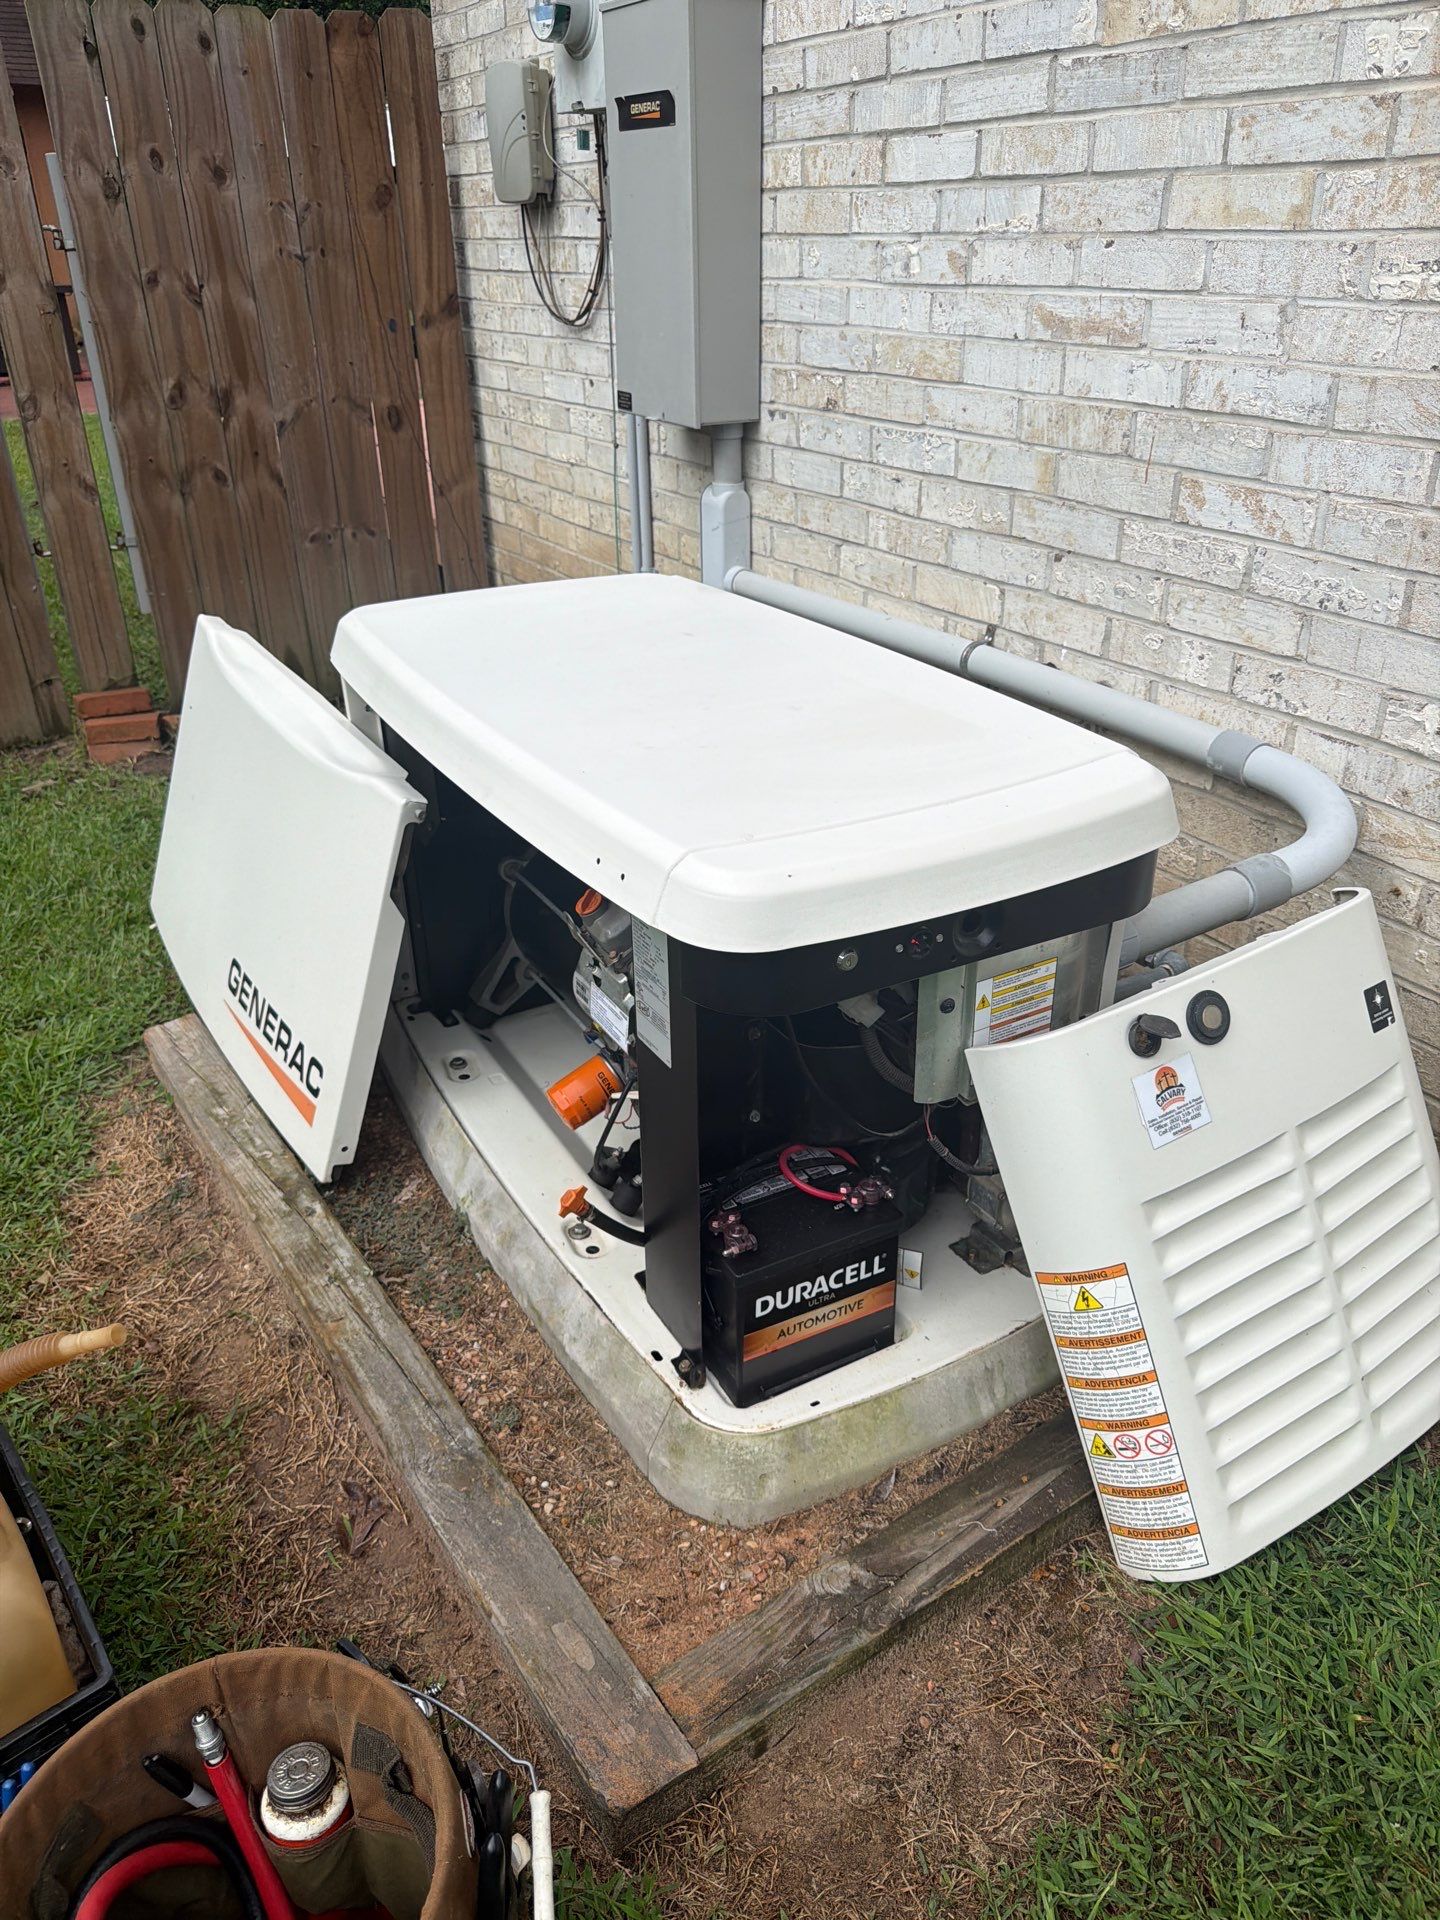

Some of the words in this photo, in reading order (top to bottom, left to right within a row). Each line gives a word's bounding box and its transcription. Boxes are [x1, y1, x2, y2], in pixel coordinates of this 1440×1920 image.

[630, 100, 661, 115] GENERAC
[227, 957, 324, 1099] GENERAC
[1156, 1088, 1186, 1107] CALVARY
[1063, 1271, 1108, 1282] WARNING
[755, 1255, 886, 1318] DURACELL
[808, 1292, 836, 1307] ULTRA
[777, 1299, 865, 1340] AUTOMOTIVE
[1068, 1332, 1142, 1347] AVERTISSEMENT
[1085, 1375, 1148, 1388] ADVERTENCIA
[1106, 1420, 1150, 1430] WARNING
[1111, 1484, 1184, 1497] AVERTISSEMENT
[1127, 1528, 1190, 1538] ADVERTENCIA
